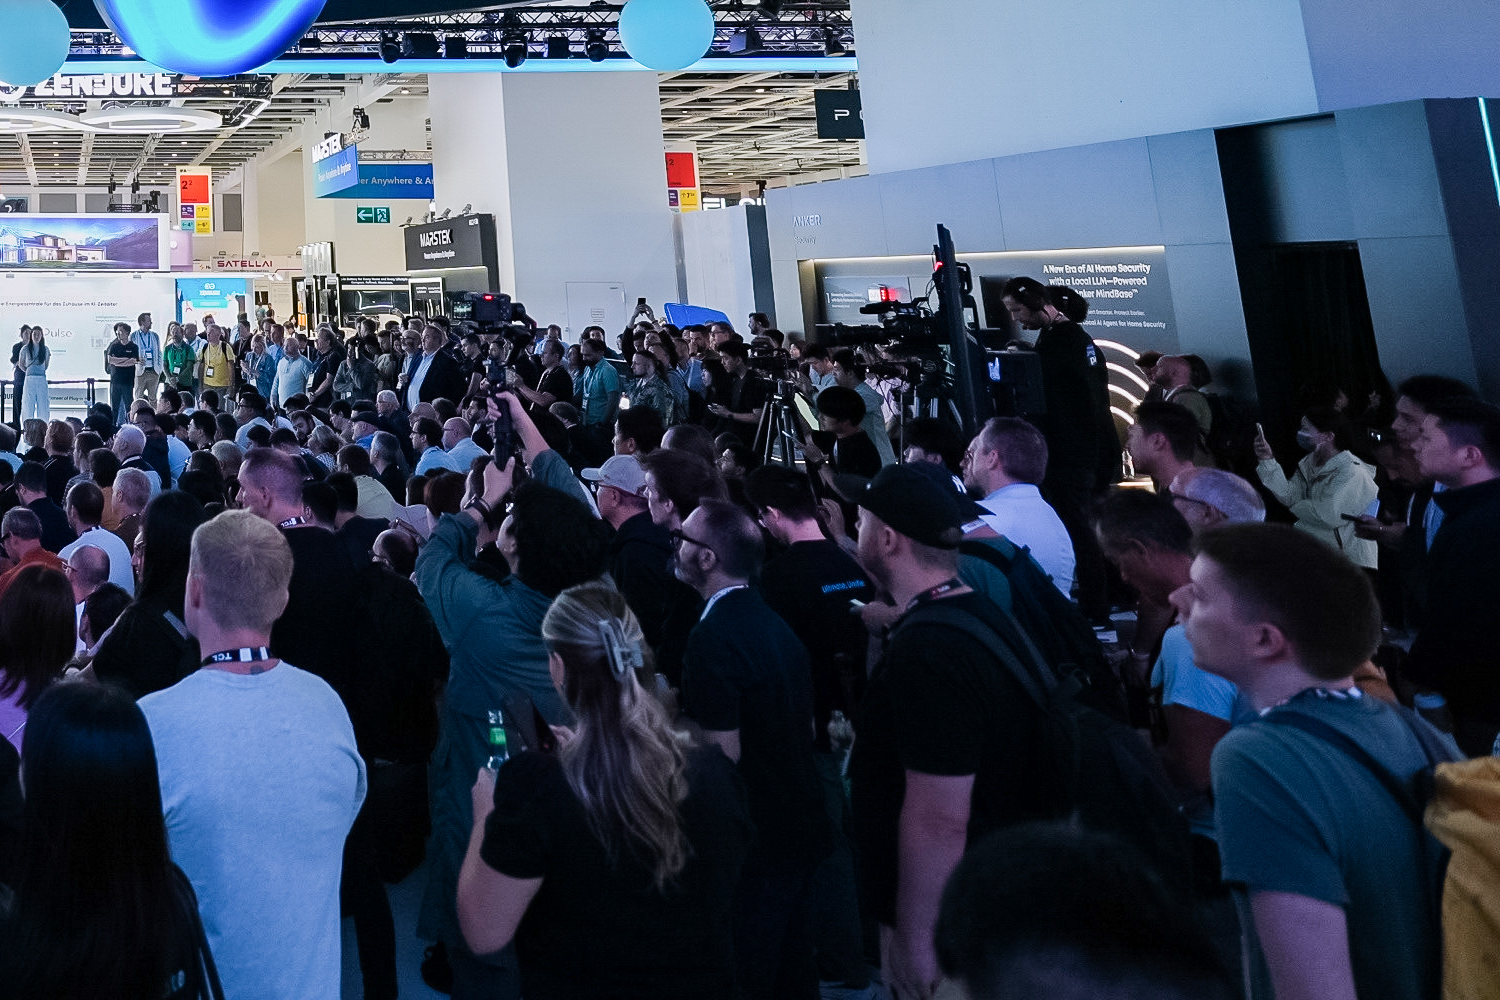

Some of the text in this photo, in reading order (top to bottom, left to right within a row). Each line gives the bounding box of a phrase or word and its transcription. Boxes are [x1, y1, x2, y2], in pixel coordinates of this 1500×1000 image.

[371, 176, 413, 187] Anywhere
[415, 177, 423, 185] &
[793, 214, 822, 227] ANKER
[419, 229, 452, 248] MARSTEK
[217, 260, 273, 268] SATELLAI
[1049, 264, 1065, 274] New
[1065, 265, 1077, 274] Era
[1078, 264, 1086, 273] of
[1095, 263, 1118, 273] Home
[1118, 262, 1151, 275] Security
[1048, 276, 1063, 286] with
[1064, 278, 1071, 286] a
[1071, 276, 1091, 286] Local
[1143, 321, 1166, 330] Security
[211, 652, 233, 662] TCL
